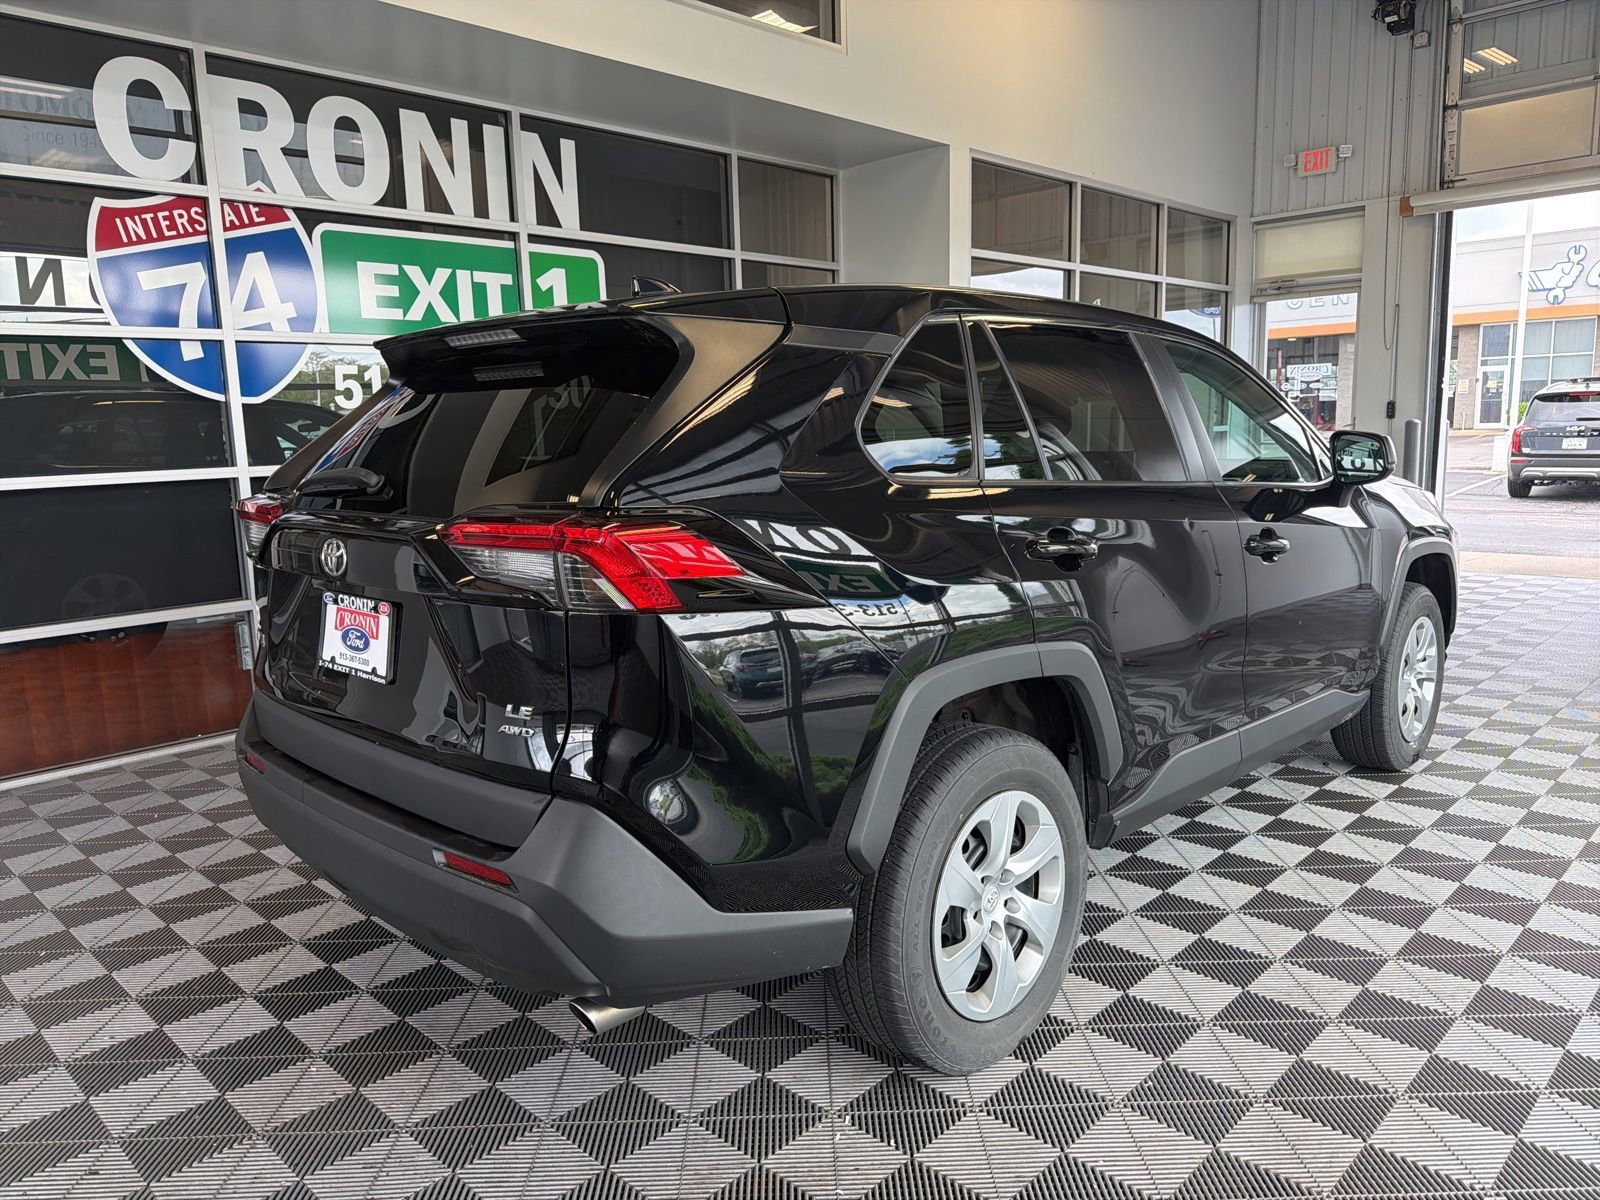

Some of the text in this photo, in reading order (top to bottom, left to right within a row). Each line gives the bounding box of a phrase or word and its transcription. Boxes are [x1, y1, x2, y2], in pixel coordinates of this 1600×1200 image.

[93, 55, 581, 231] CRONIN
[1303, 148, 1331, 172] EXIT
[115, 202, 266, 243] INTERSATE
[356, 260, 569, 323] EXIT 1
[137, 250, 297, 362] 74
[336, 610, 379, 639] CRONIN
[346, 630, 365, 649] Ford
[318, 659, 386, 684] I-74 EXIT 1 Harrison
[505, 703, 535, 720] LE
[497, 724, 535, 737] AWD
